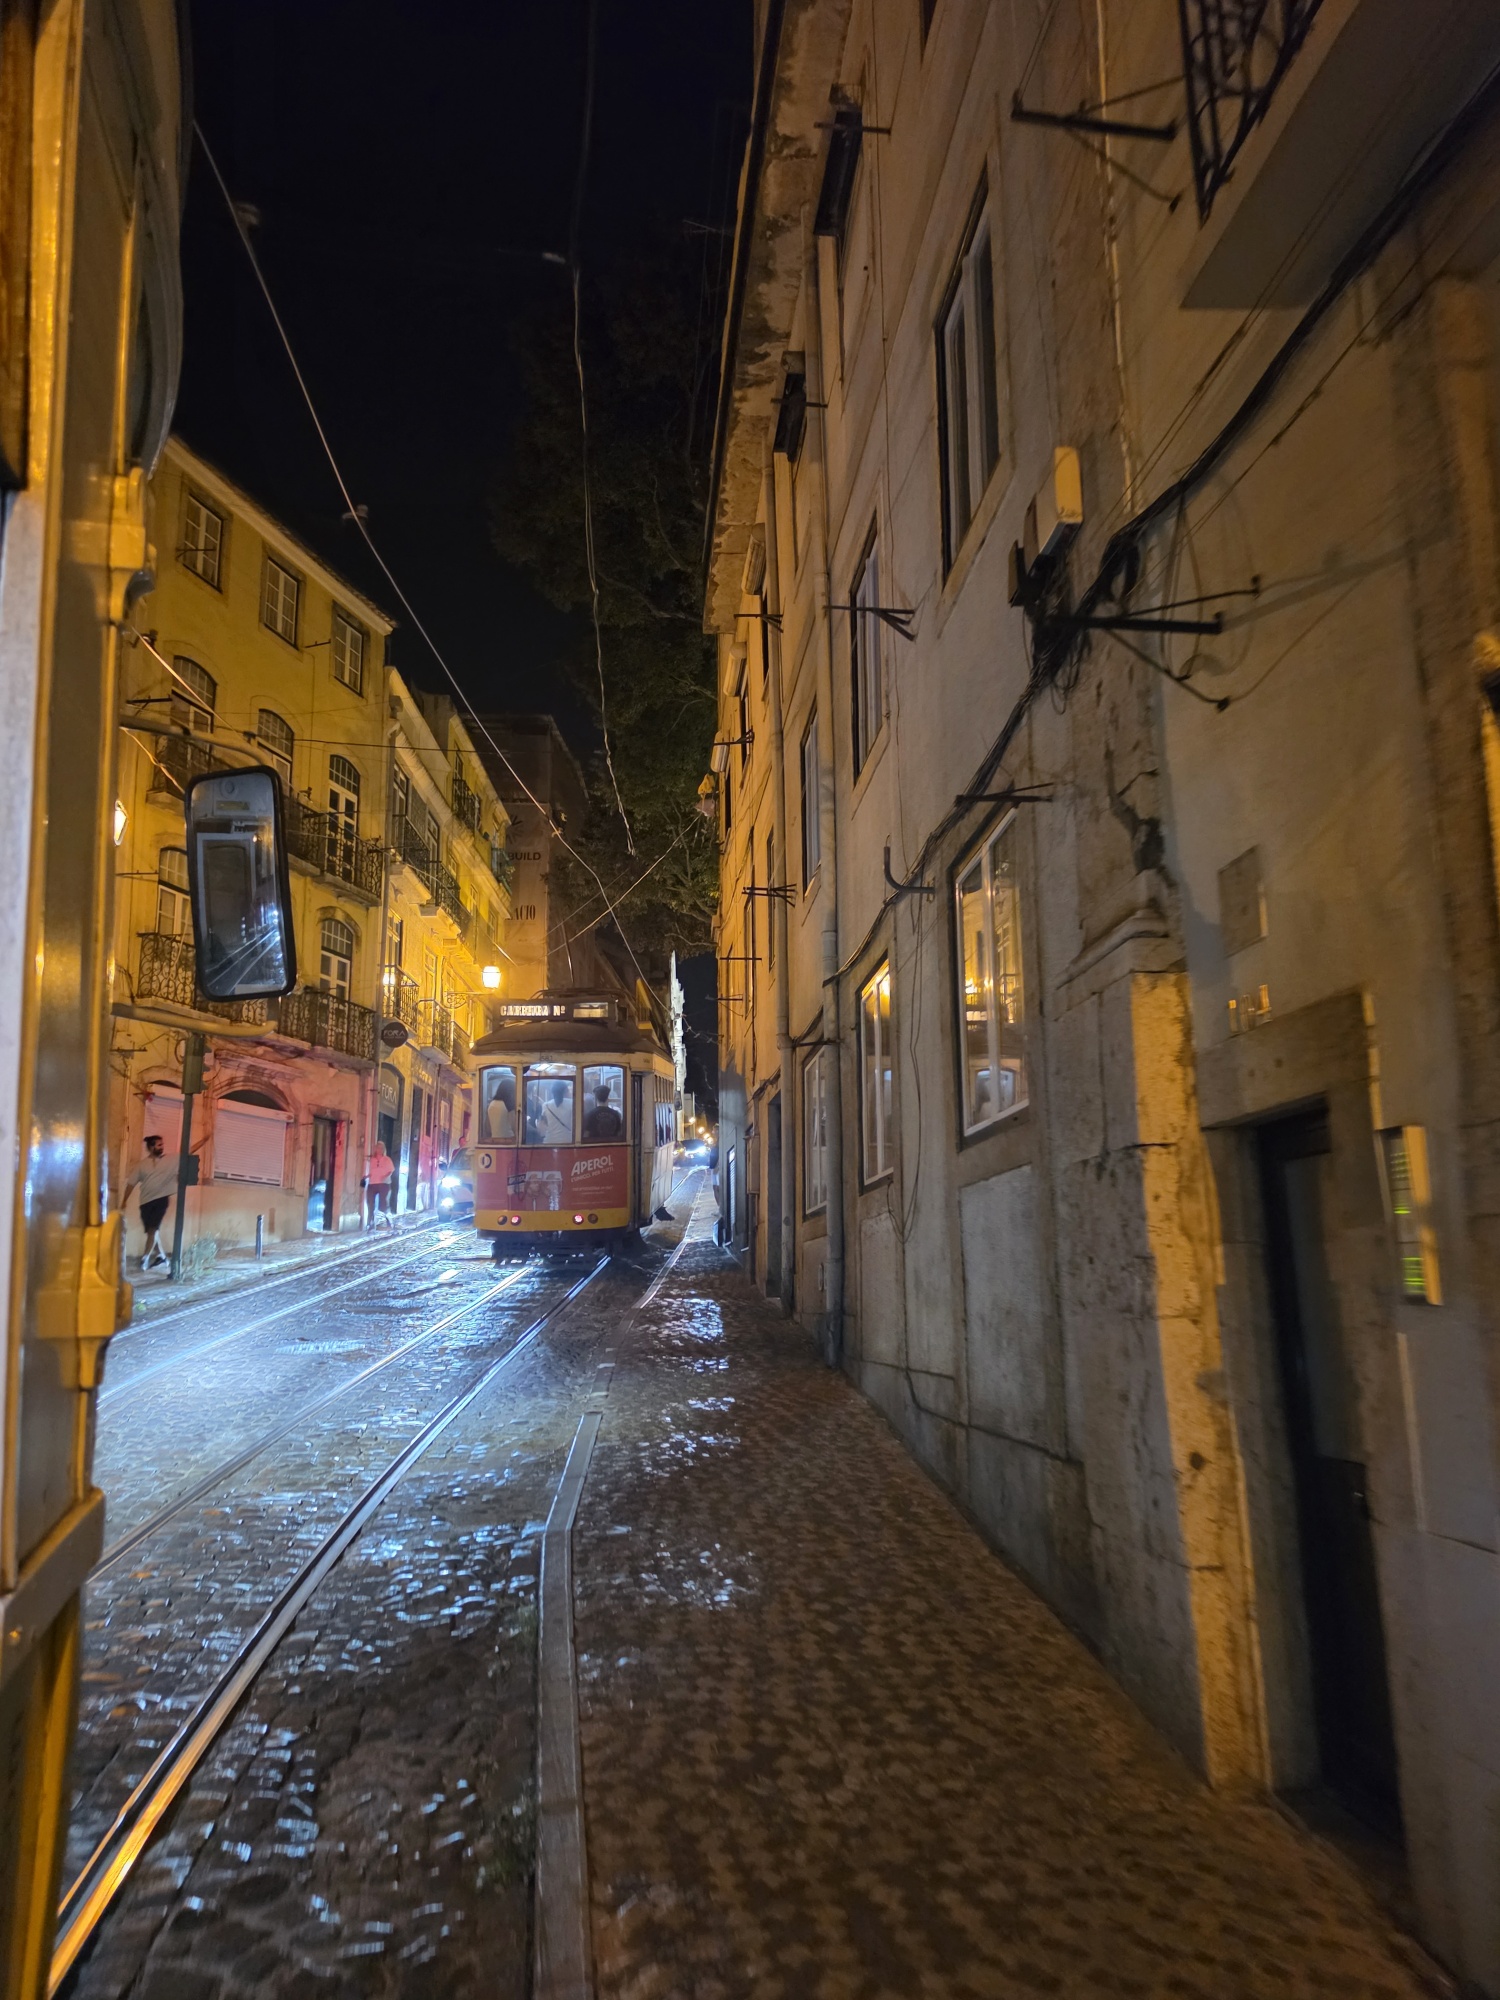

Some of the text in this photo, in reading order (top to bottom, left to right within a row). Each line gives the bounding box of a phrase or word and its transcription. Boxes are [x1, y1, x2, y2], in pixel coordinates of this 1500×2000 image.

[508, 852, 541, 861] BUILD
[383, 1029, 406, 1037] FORA
[381, 1083, 397, 1104] FORA
[571, 1154, 614, 1177] APEROL
